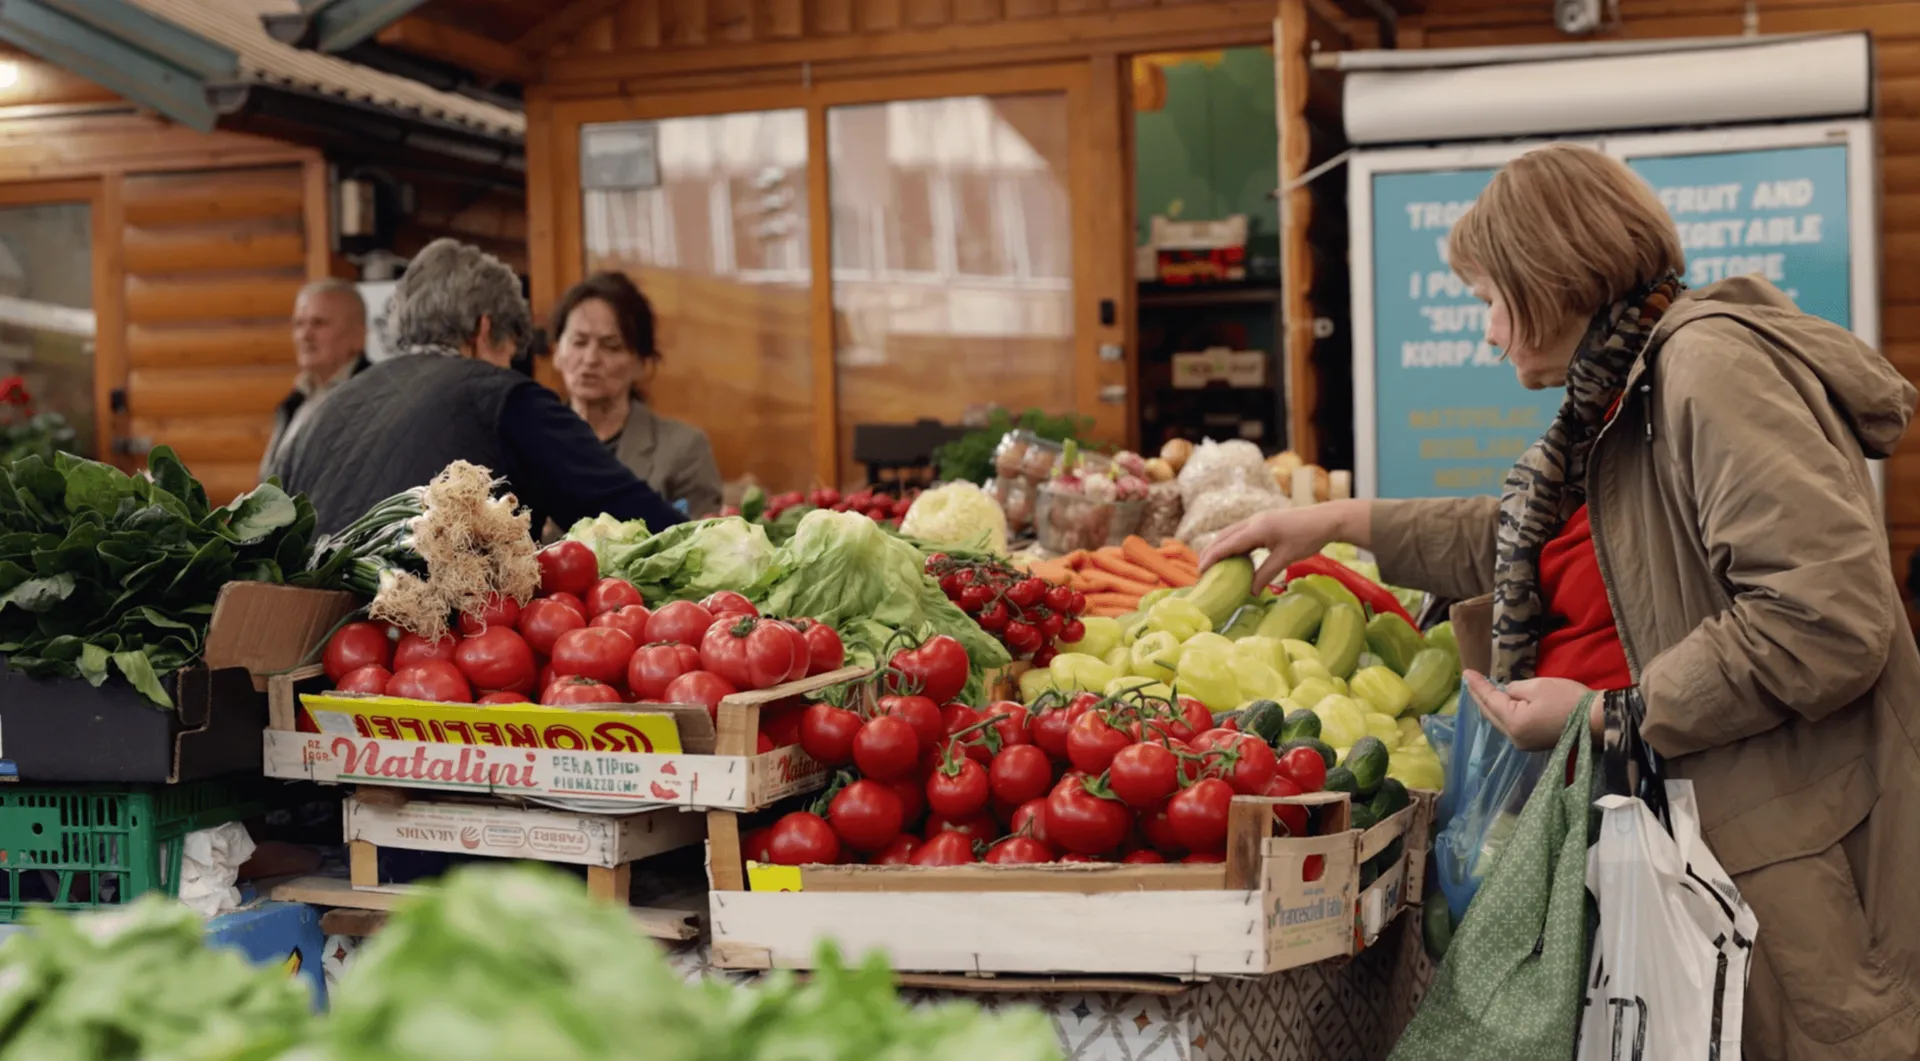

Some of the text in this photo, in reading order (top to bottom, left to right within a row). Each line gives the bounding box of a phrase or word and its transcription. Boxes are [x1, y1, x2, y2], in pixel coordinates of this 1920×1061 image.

[1660, 178, 1814, 212] FRUIT AND
[1677, 214, 1823, 247] EGETABLE
[331, 737, 539, 788] Natalini
[534, 831, 584, 843] FABBRI
